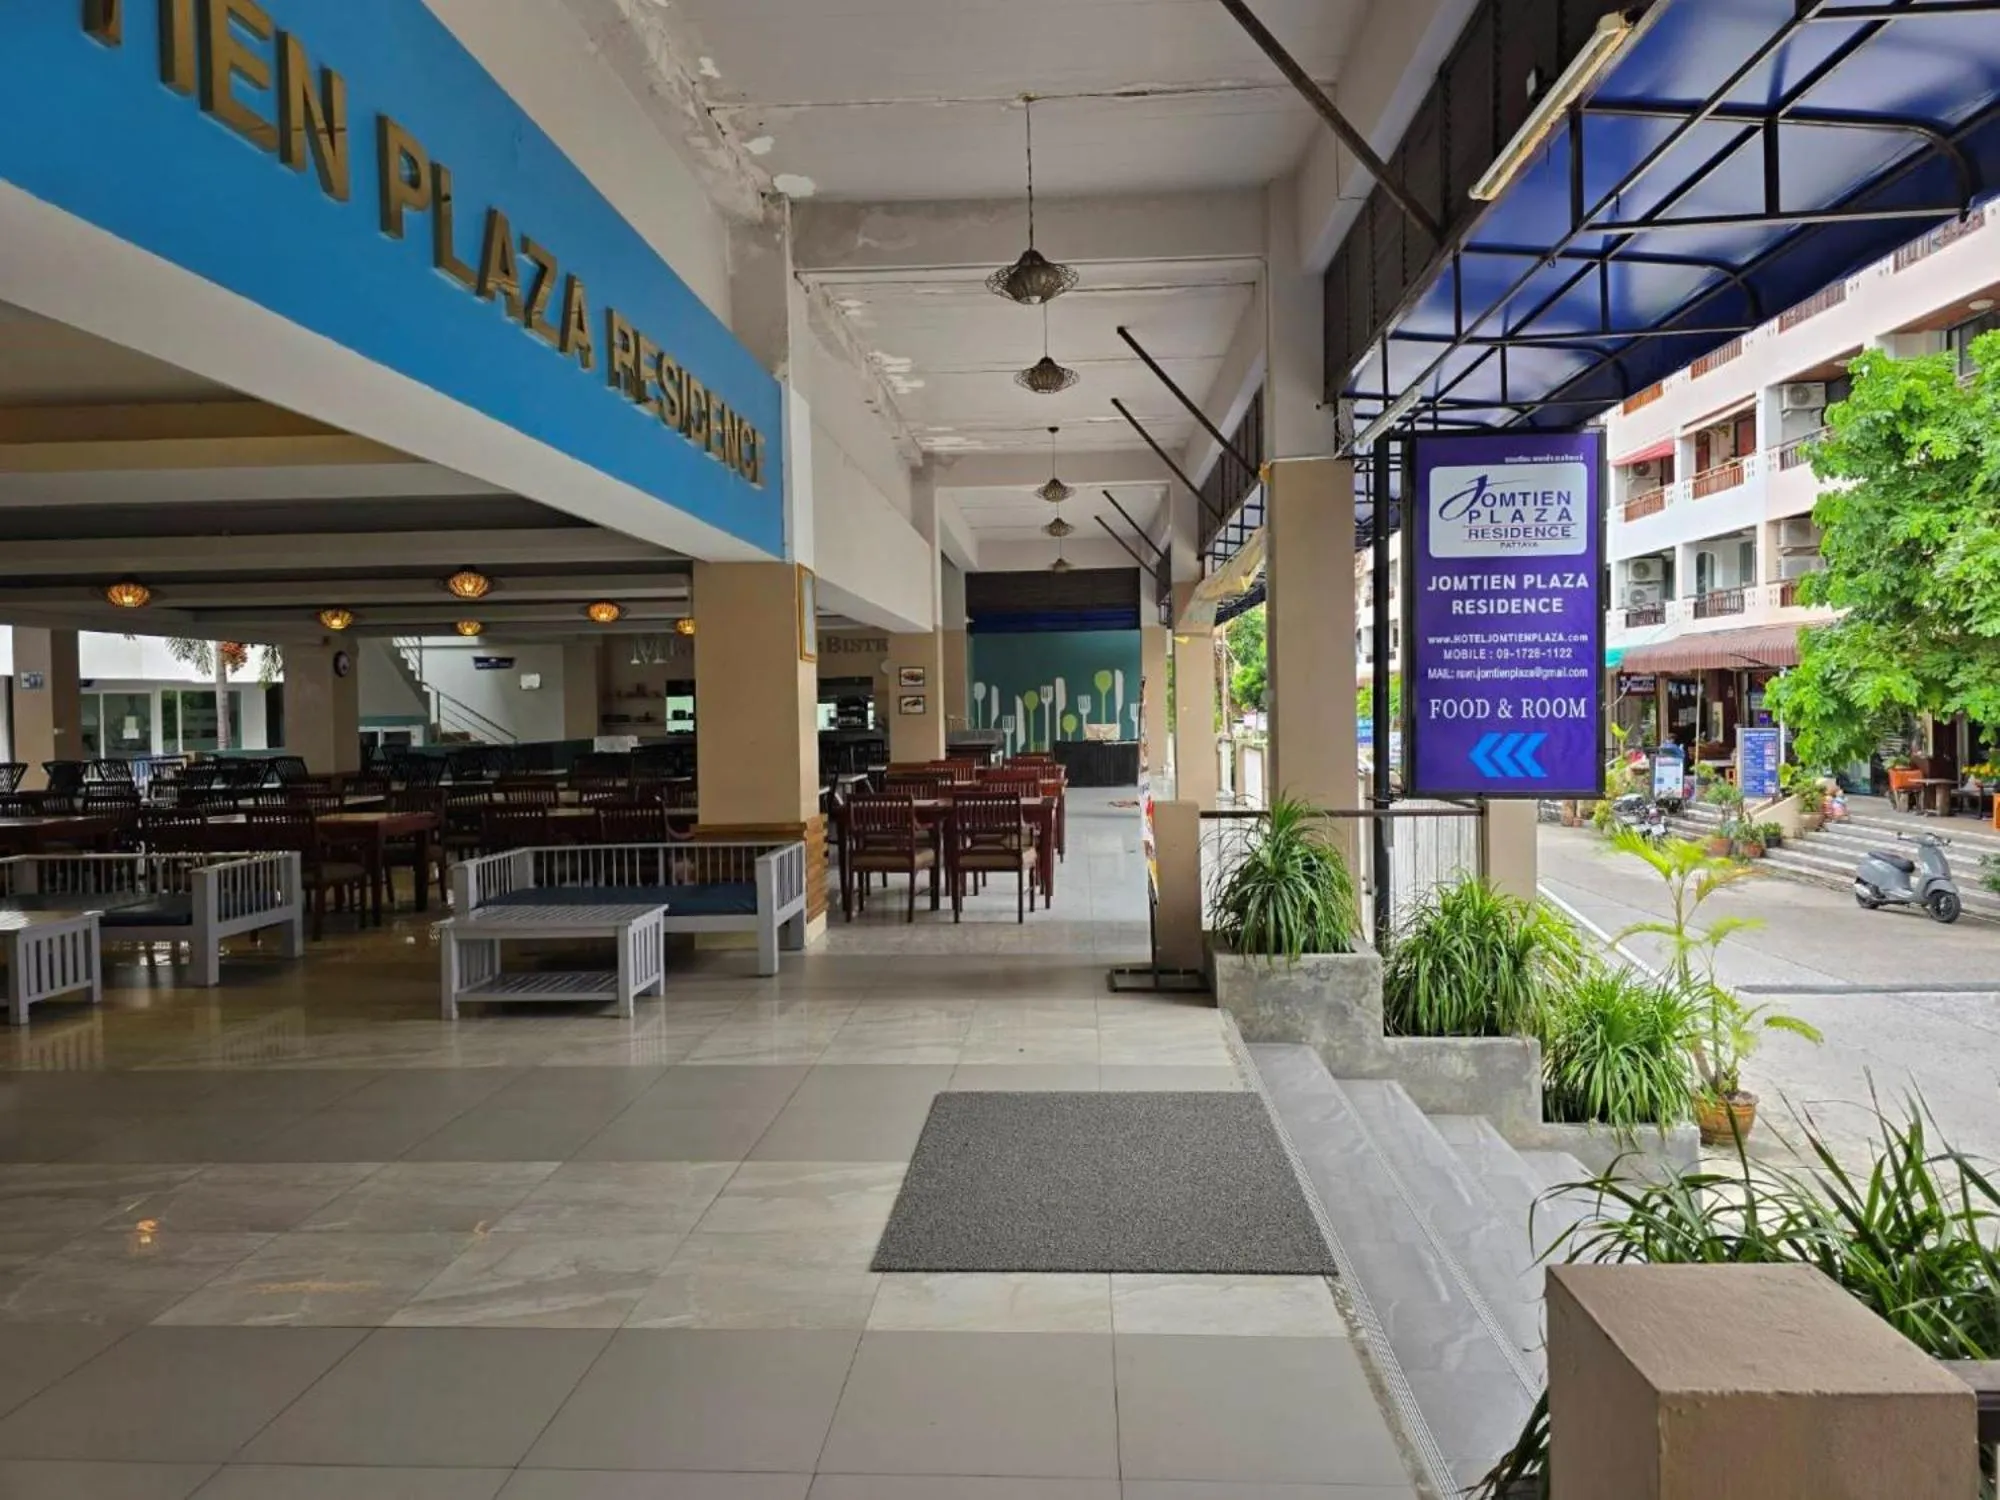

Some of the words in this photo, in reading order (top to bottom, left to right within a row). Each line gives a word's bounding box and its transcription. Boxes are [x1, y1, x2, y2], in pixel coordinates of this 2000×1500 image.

[376, 112, 595, 372] PLAZA
[606, 306, 766, 489] RESIDENCE
[1438, 474, 1571, 521] JOMTIEN
[1468, 507, 1573, 524] PLAZA
[1468, 525, 1571, 540] RESIDENCE
[1427, 574, 1516, 591] JOMTIEN
[1523, 573, 1589, 589] PLAZA
[1451, 598, 1564, 615] RESIDENCE
[1443, 649, 1486, 661] MOBILE
[1429, 698, 1490, 720] FOOD
[1497, 698, 1513, 719] &
[1521, 697, 1588, 720] ROOM
